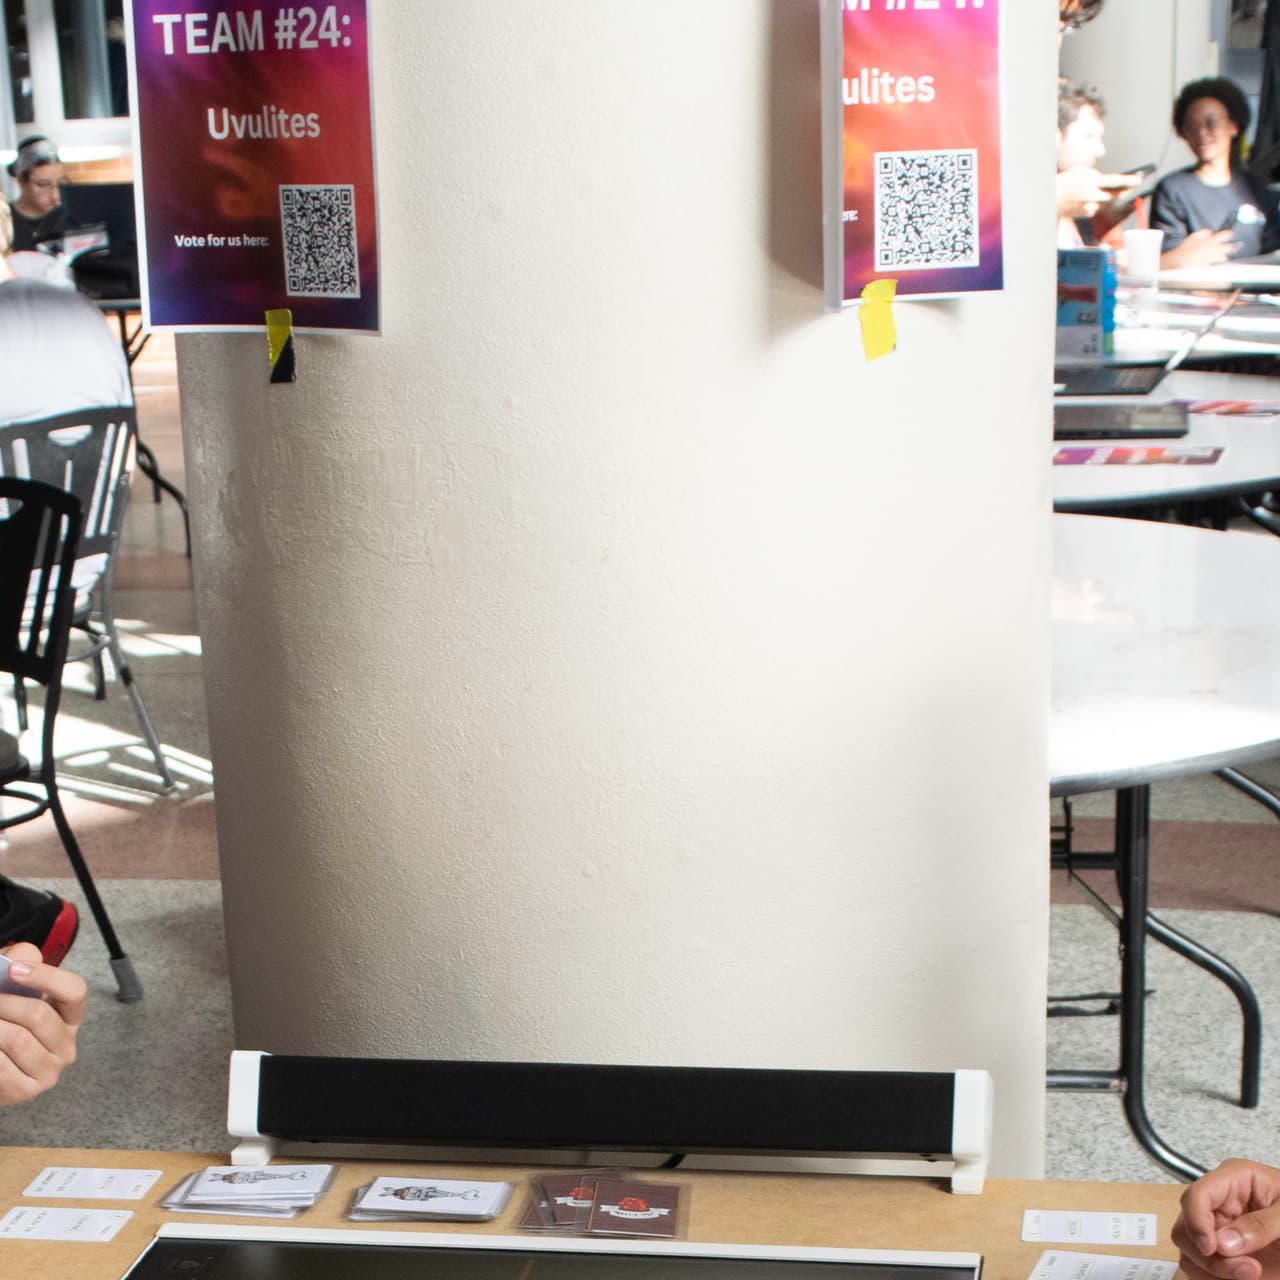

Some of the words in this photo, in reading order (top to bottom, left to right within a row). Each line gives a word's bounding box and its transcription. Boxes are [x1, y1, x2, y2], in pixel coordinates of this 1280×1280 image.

[152, 9, 265, 55] TEAM
[274, 5, 352, 50] #24:
[842, 67, 936, 105] ulites
[207, 104, 321, 140] Uvulites
[174, 234, 205, 247] Vote
[207, 233, 225, 246] for
[227, 236, 242, 247] us
[243, 233, 269, 247] here:
